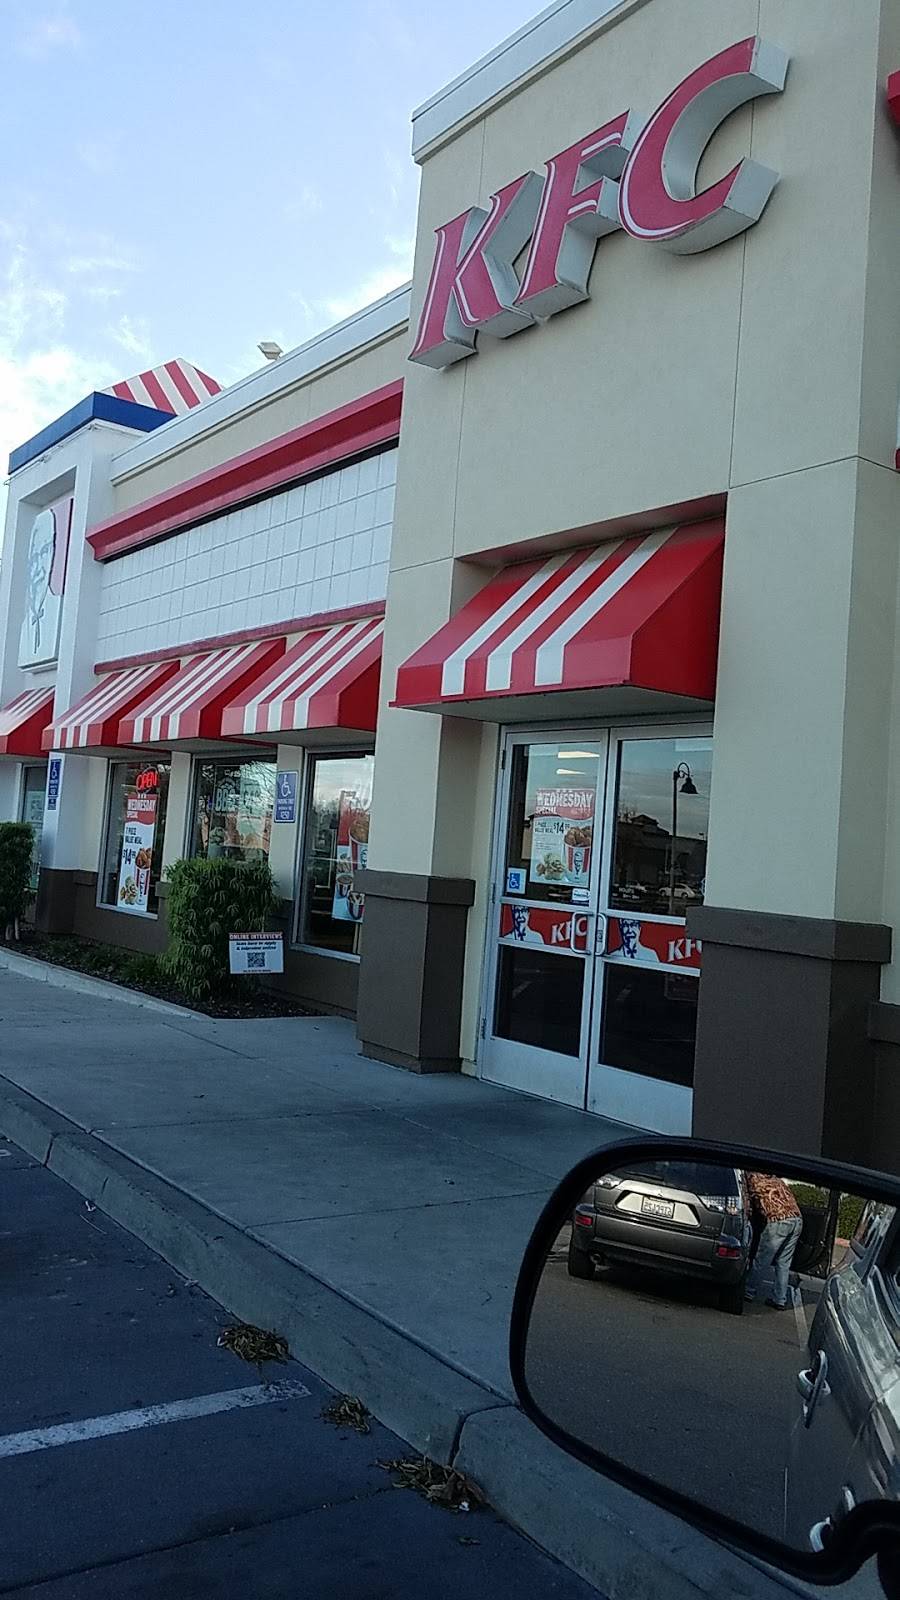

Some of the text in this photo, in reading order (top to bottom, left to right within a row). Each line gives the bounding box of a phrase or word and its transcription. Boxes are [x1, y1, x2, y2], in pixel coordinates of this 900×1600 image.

[408, 35, 775, 364] KFC
[136, 771, 157, 791] OPEN
[536, 791, 593, 807] WEDNESDAY
[535, 805, 558, 815] SPECIAL
